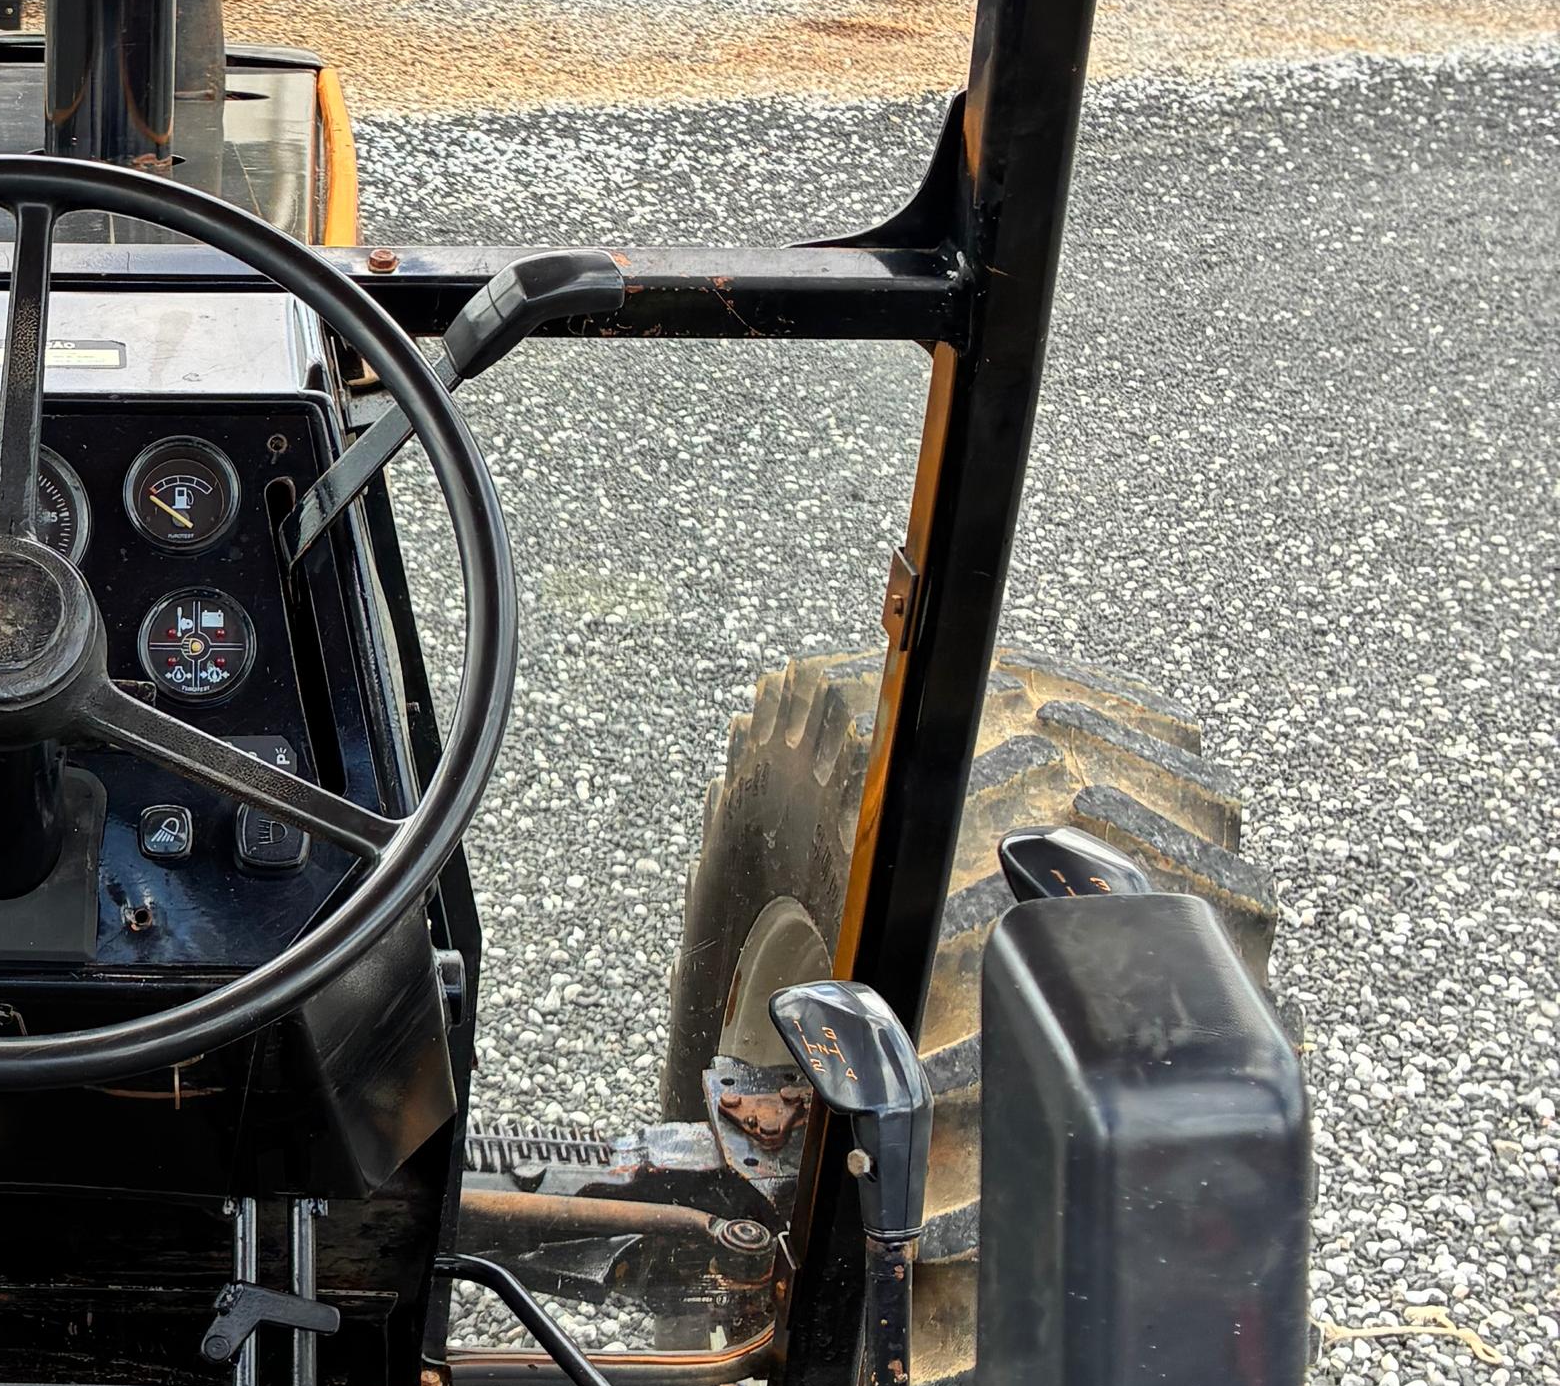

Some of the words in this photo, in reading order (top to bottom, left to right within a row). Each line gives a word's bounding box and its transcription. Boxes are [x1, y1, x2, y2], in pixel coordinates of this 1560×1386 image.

[1090, 876, 1111, 892] 3
[822, 1026, 837, 1040] 3
[817, 1043, 830, 1055] N
[810, 1058, 826, 1072] 2
[845, 1067, 858, 1081] 4
